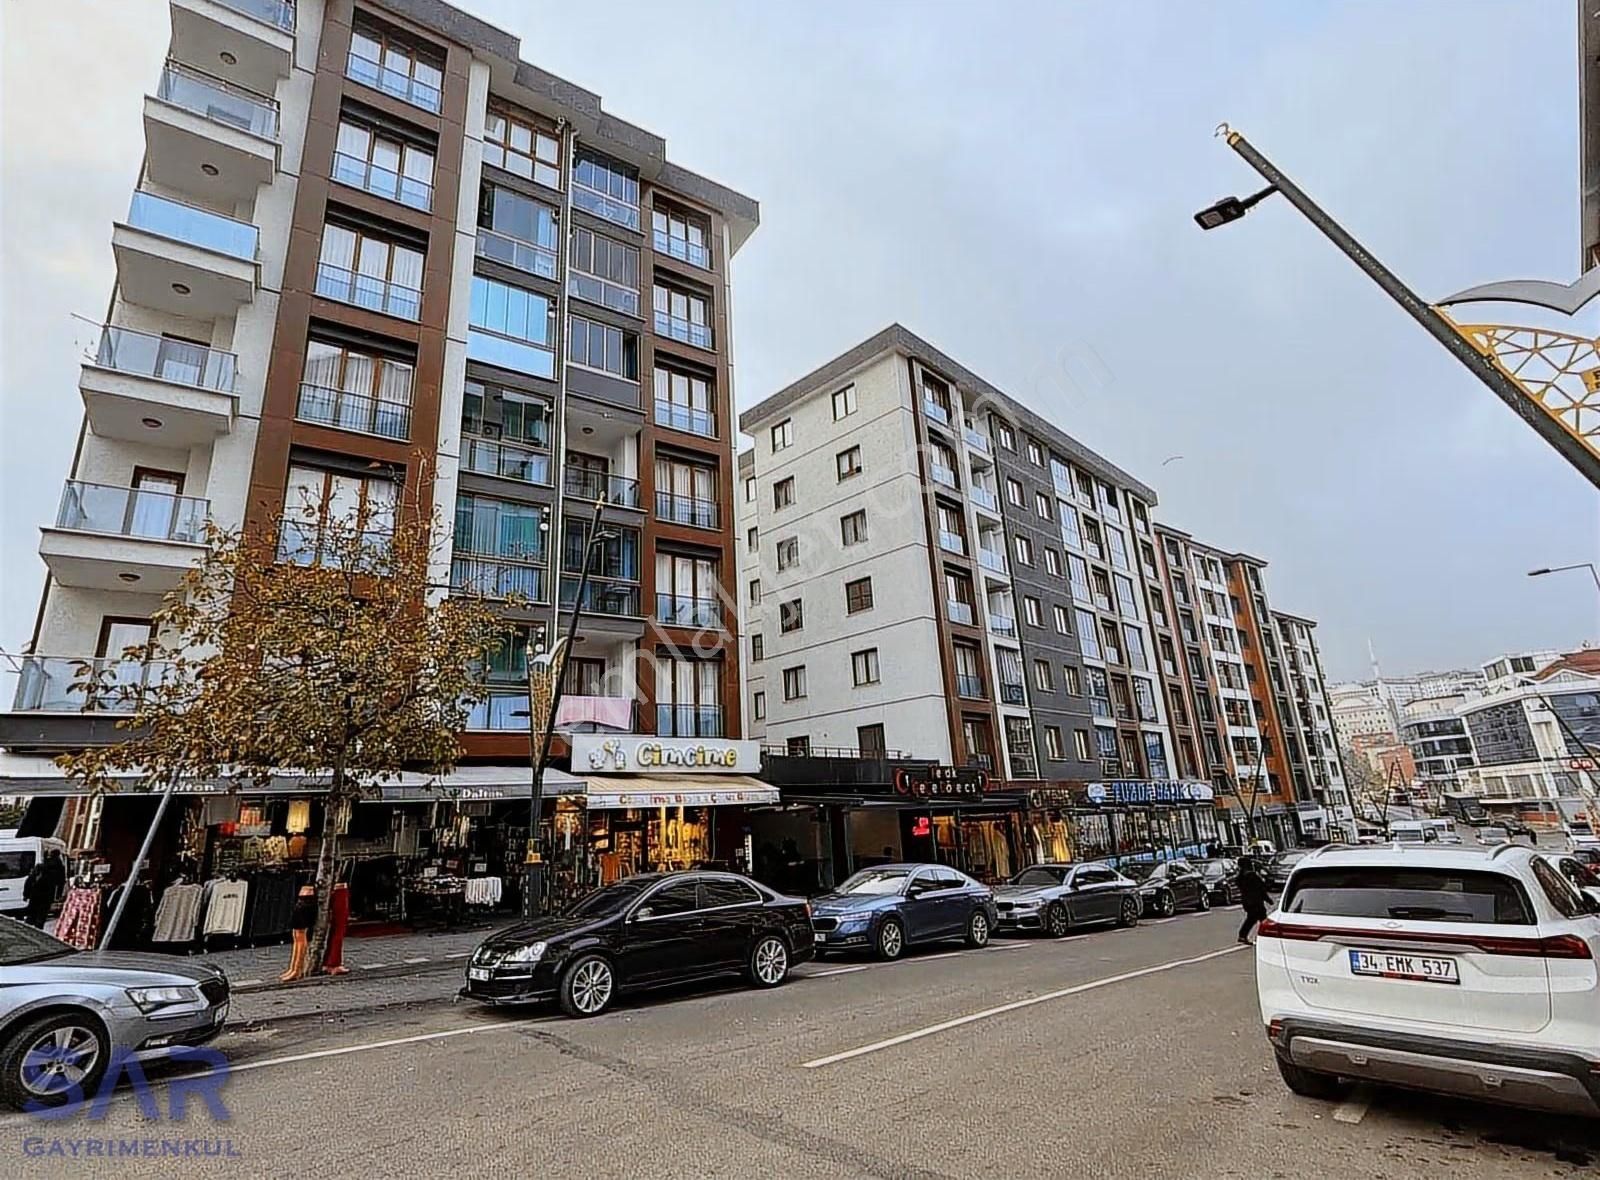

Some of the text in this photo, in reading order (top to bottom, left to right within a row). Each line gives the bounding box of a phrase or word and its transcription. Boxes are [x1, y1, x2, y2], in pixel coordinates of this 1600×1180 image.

[636, 741, 737, 767] Cimcime
[1361, 954, 1378, 970] 34
[1422, 959, 1452, 977] 537
